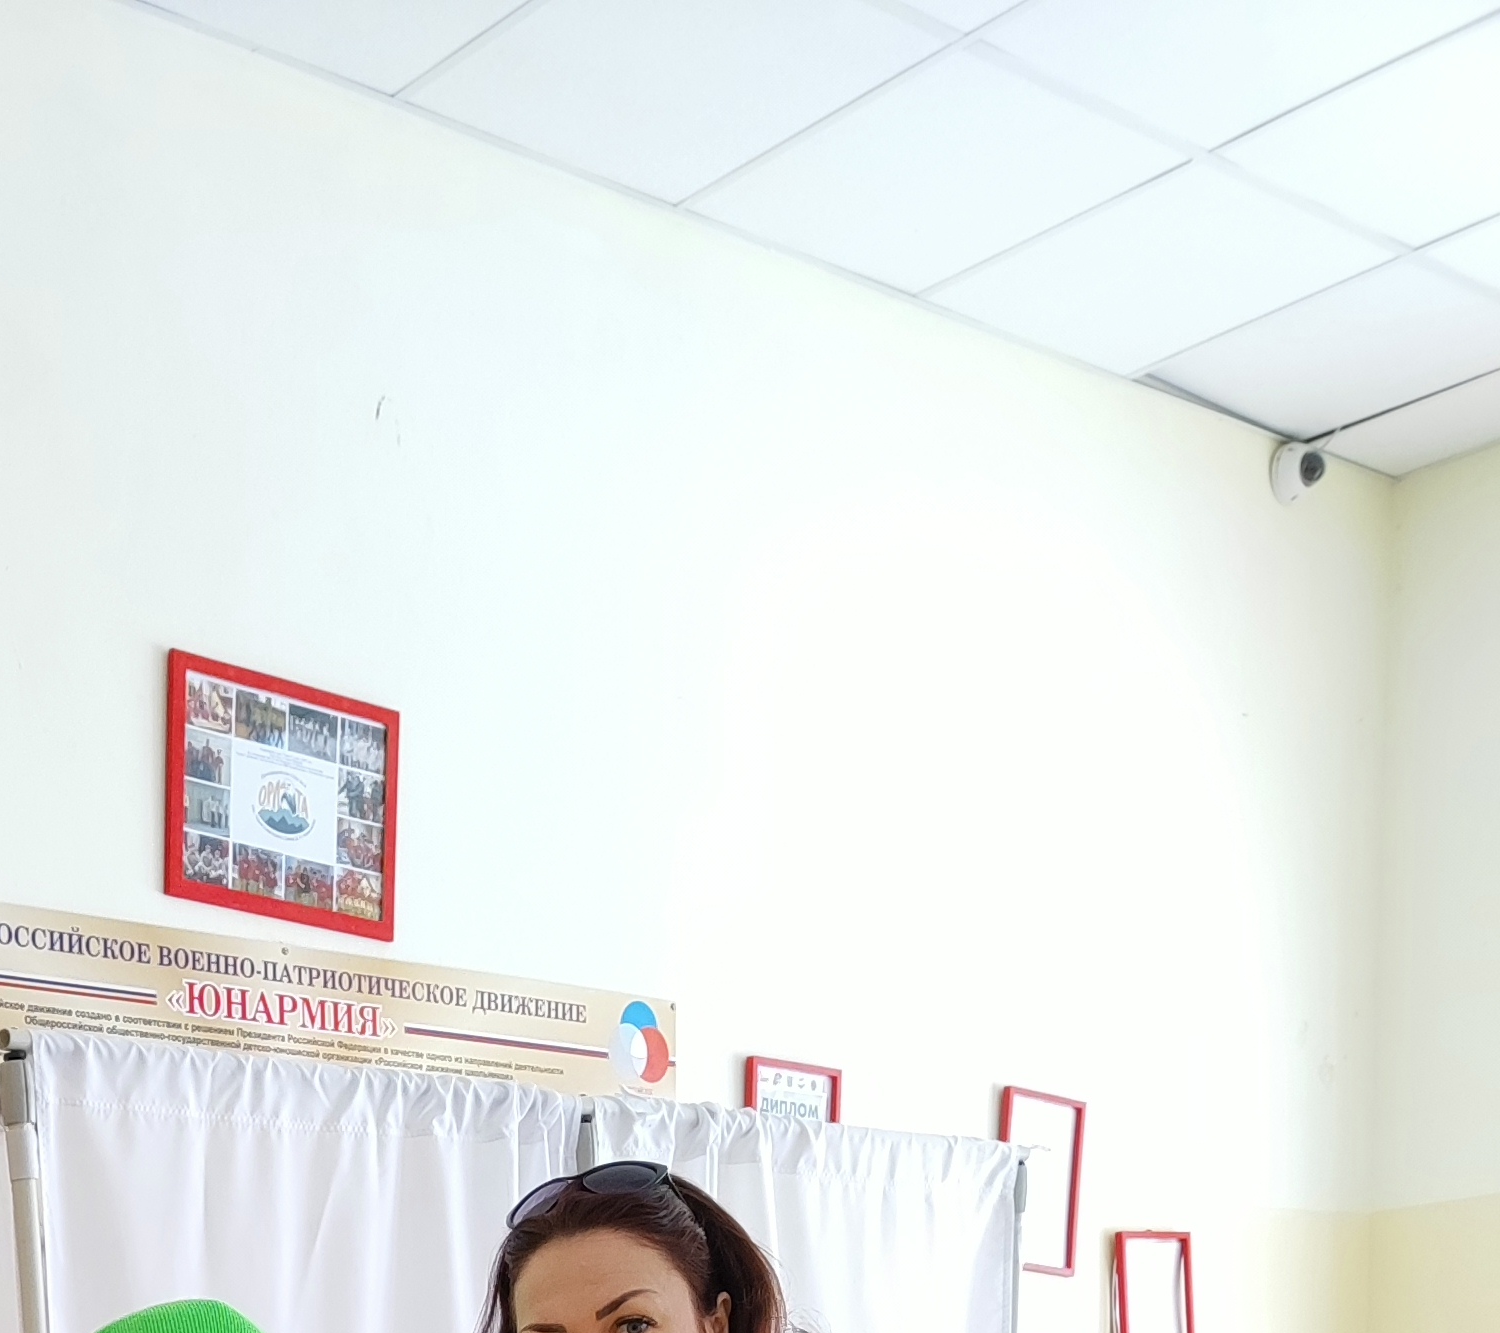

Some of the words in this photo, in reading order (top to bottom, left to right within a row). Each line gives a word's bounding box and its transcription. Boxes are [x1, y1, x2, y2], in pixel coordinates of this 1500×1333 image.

[157, 943, 468, 1008] ВОЕННО-ПАТРИОТИЧЕСКОЕ
[471, 988, 588, 1025] ДВИЖЕНИЕ
[24, 1014, 104, 1034] Общероссийской
[26, 1002, 73, 1017] движение
[75, 1009, 112, 1022] создано
[122, 1014, 182, 1030] соответствии
[191, 1023, 235, 1038] решением
[236, 1027, 286, 1043] Президента
[167, 979, 397, 1038] «ЮНАРМИЯ»
[760, 1096, 819, 1120] ДИПЛОМ
